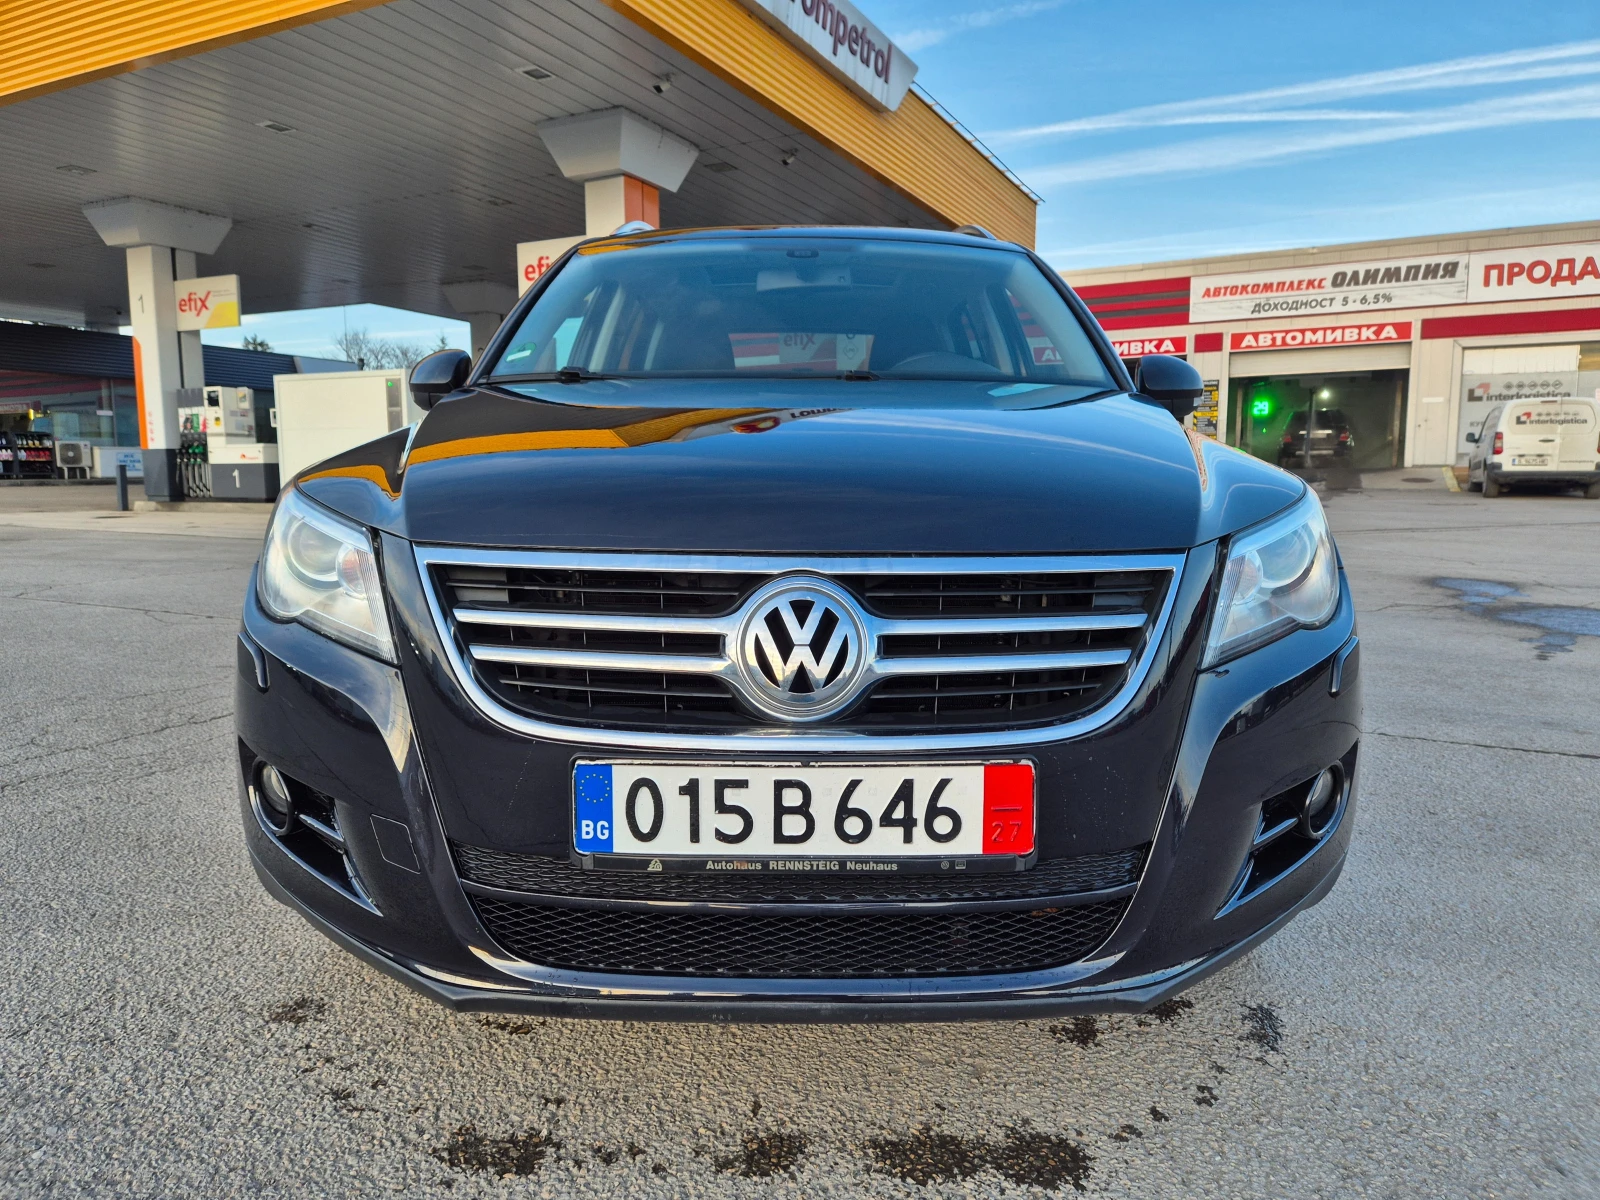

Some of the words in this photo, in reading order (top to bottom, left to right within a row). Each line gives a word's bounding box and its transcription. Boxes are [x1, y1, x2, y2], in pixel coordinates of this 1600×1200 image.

[789, 0, 892, 84] ompetrol
[1202, 277, 1327, 298] АВТОКОМПЛЕКС
[1331, 261, 1460, 288] ОЛИМПИЯ
[178, 291, 211, 317] efix
[1251, 297, 1336, 314] ДОХОДНОСТ
[1341, 296, 1349, 306] 5
[1360, 293, 1393, 306] 6,5%
[1113, 339, 1176, 355] ИВКА
[1240, 325, 1398, 348] АВТОМИВКА
[1253, 401, 1269, 415] 29
[1528, 417, 1588, 427] interlogistica
[232, 468, 240, 489] 1
[581, 820, 610, 840] BG
[991, 821, 1022, 842] 27
[706, 860, 762, 870] Autohaus
[769, 860, 840, 871] RENNSTEIG
[846, 861, 898, 871] Neuhaus
